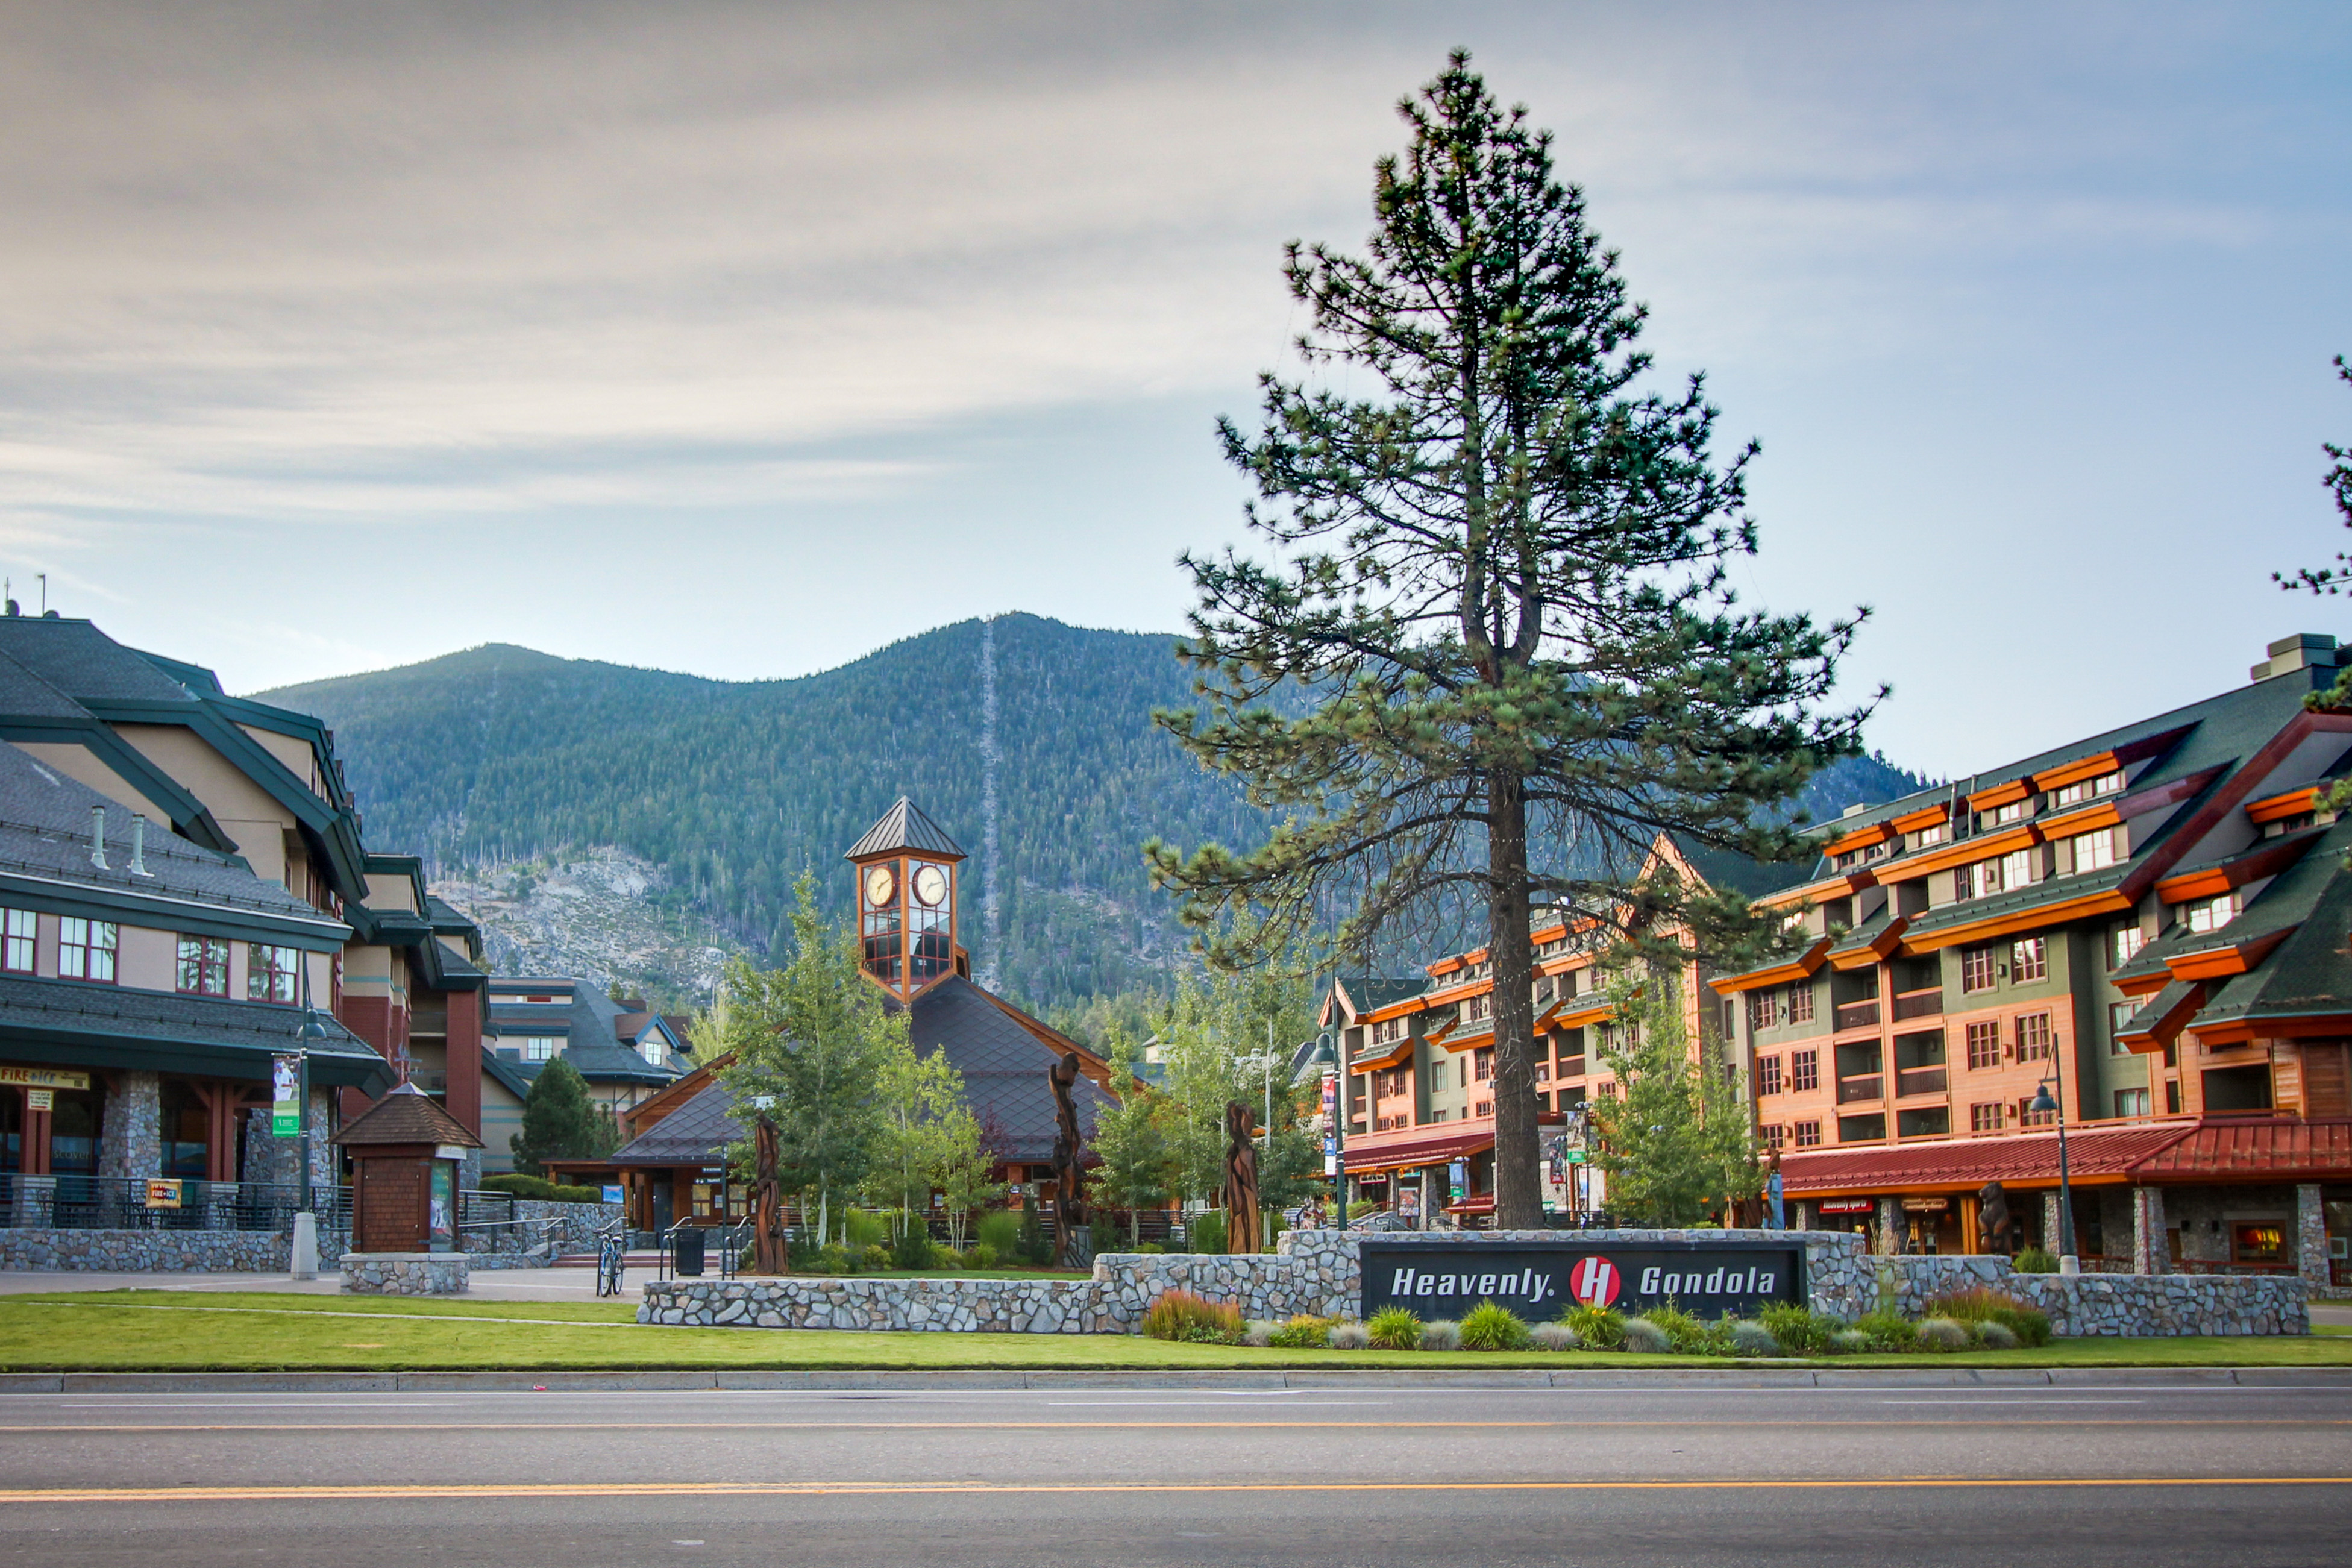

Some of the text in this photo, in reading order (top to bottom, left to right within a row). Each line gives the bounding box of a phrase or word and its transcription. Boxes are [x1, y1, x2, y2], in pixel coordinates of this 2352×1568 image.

[51, 1150, 89, 1159] iscover
[1579, 1257, 1612, 1309] H
[1640, 1267, 1775, 1294] Gondola
